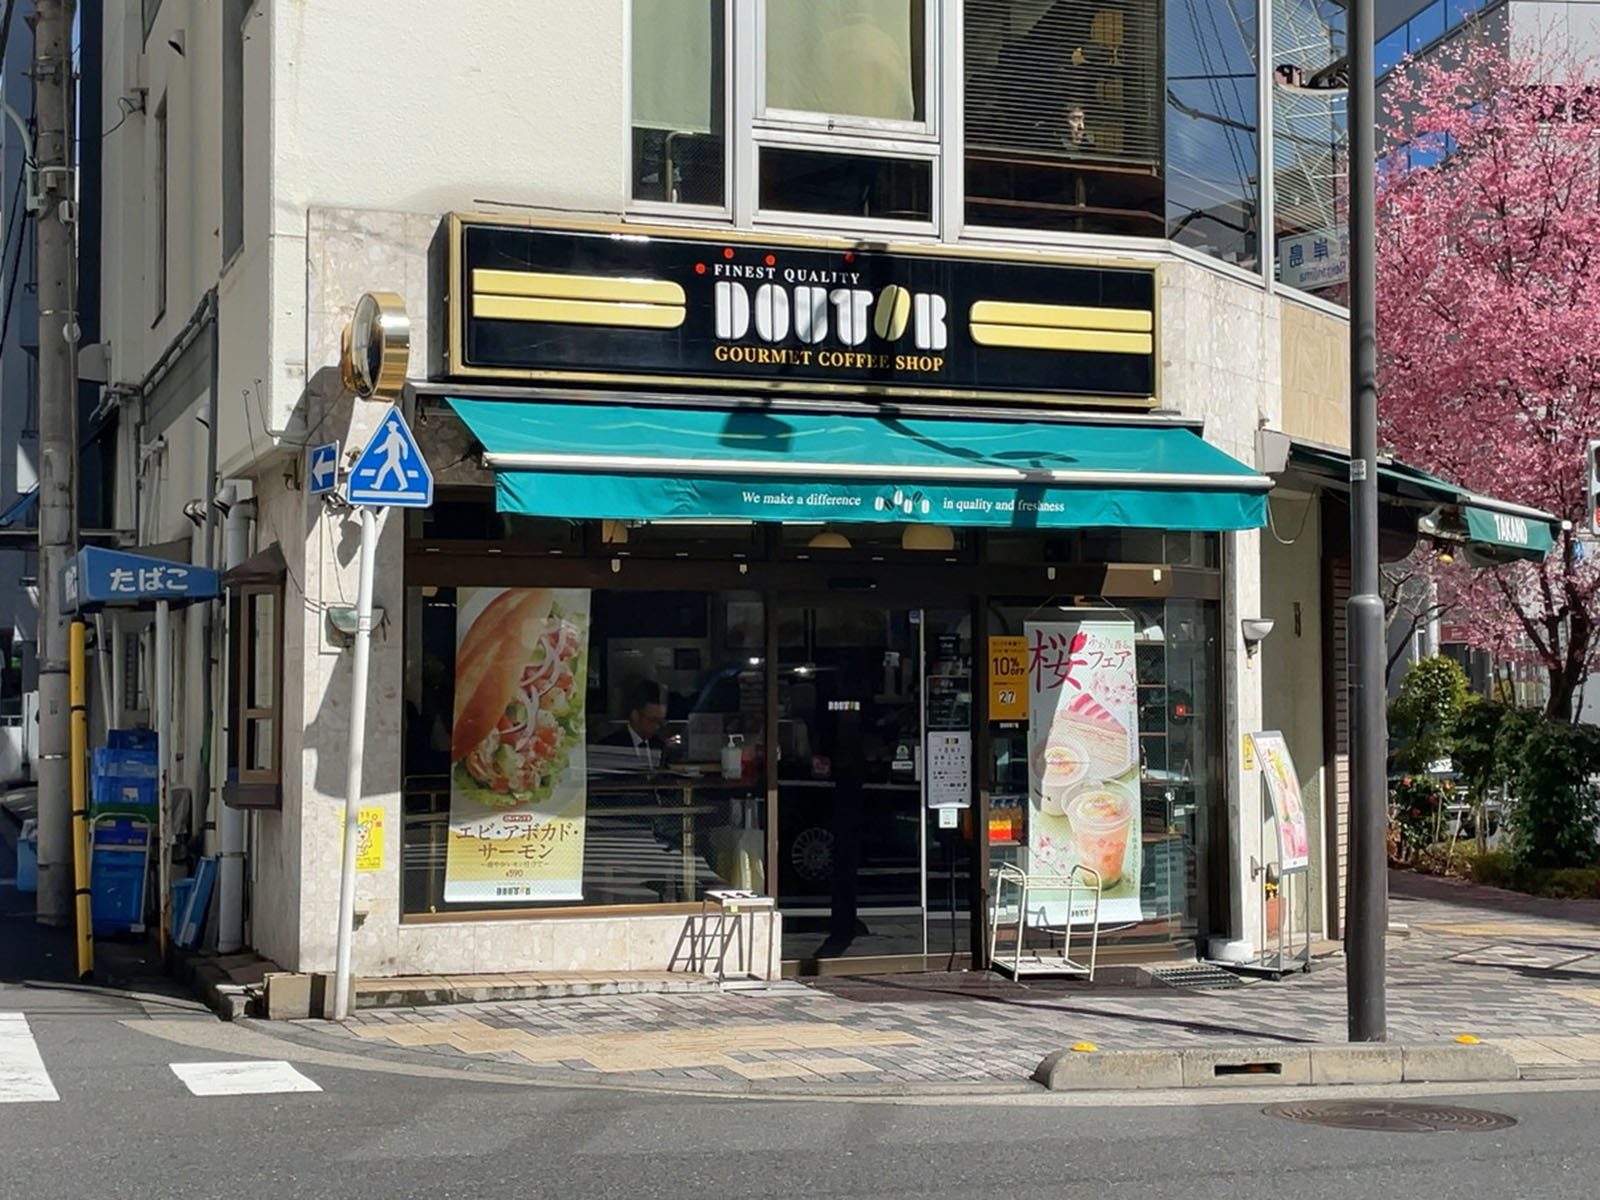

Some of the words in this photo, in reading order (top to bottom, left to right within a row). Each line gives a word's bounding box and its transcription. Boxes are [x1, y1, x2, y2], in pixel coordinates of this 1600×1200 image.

[714, 264, 776, 280] FINEST
[784, 268, 861, 284] QUALITY
[714, 281, 948, 350] DOUTOR
[714, 346, 812, 365] GOURMET
[818, 351, 890, 369] COFFEE
[895, 355, 944, 372] SHOP
[742, 491, 761, 504] We
[763, 493, 795, 505] make
[796, 496, 804, 505] a
[806, 493, 861, 506] difference
[943, 497, 954, 509] in
[956, 498, 992, 513] quality
[995, 499, 1014, 511] and
[109, 565, 188, 592] たばこ
[992, 656, 1020, 676] 10%
[1029, 629, 1088, 693] 桜
[1088, 650, 1131, 671] フェア
[455, 823, 579, 841] エビ・アボカド・
[478, 843, 554, 861] サーモン
